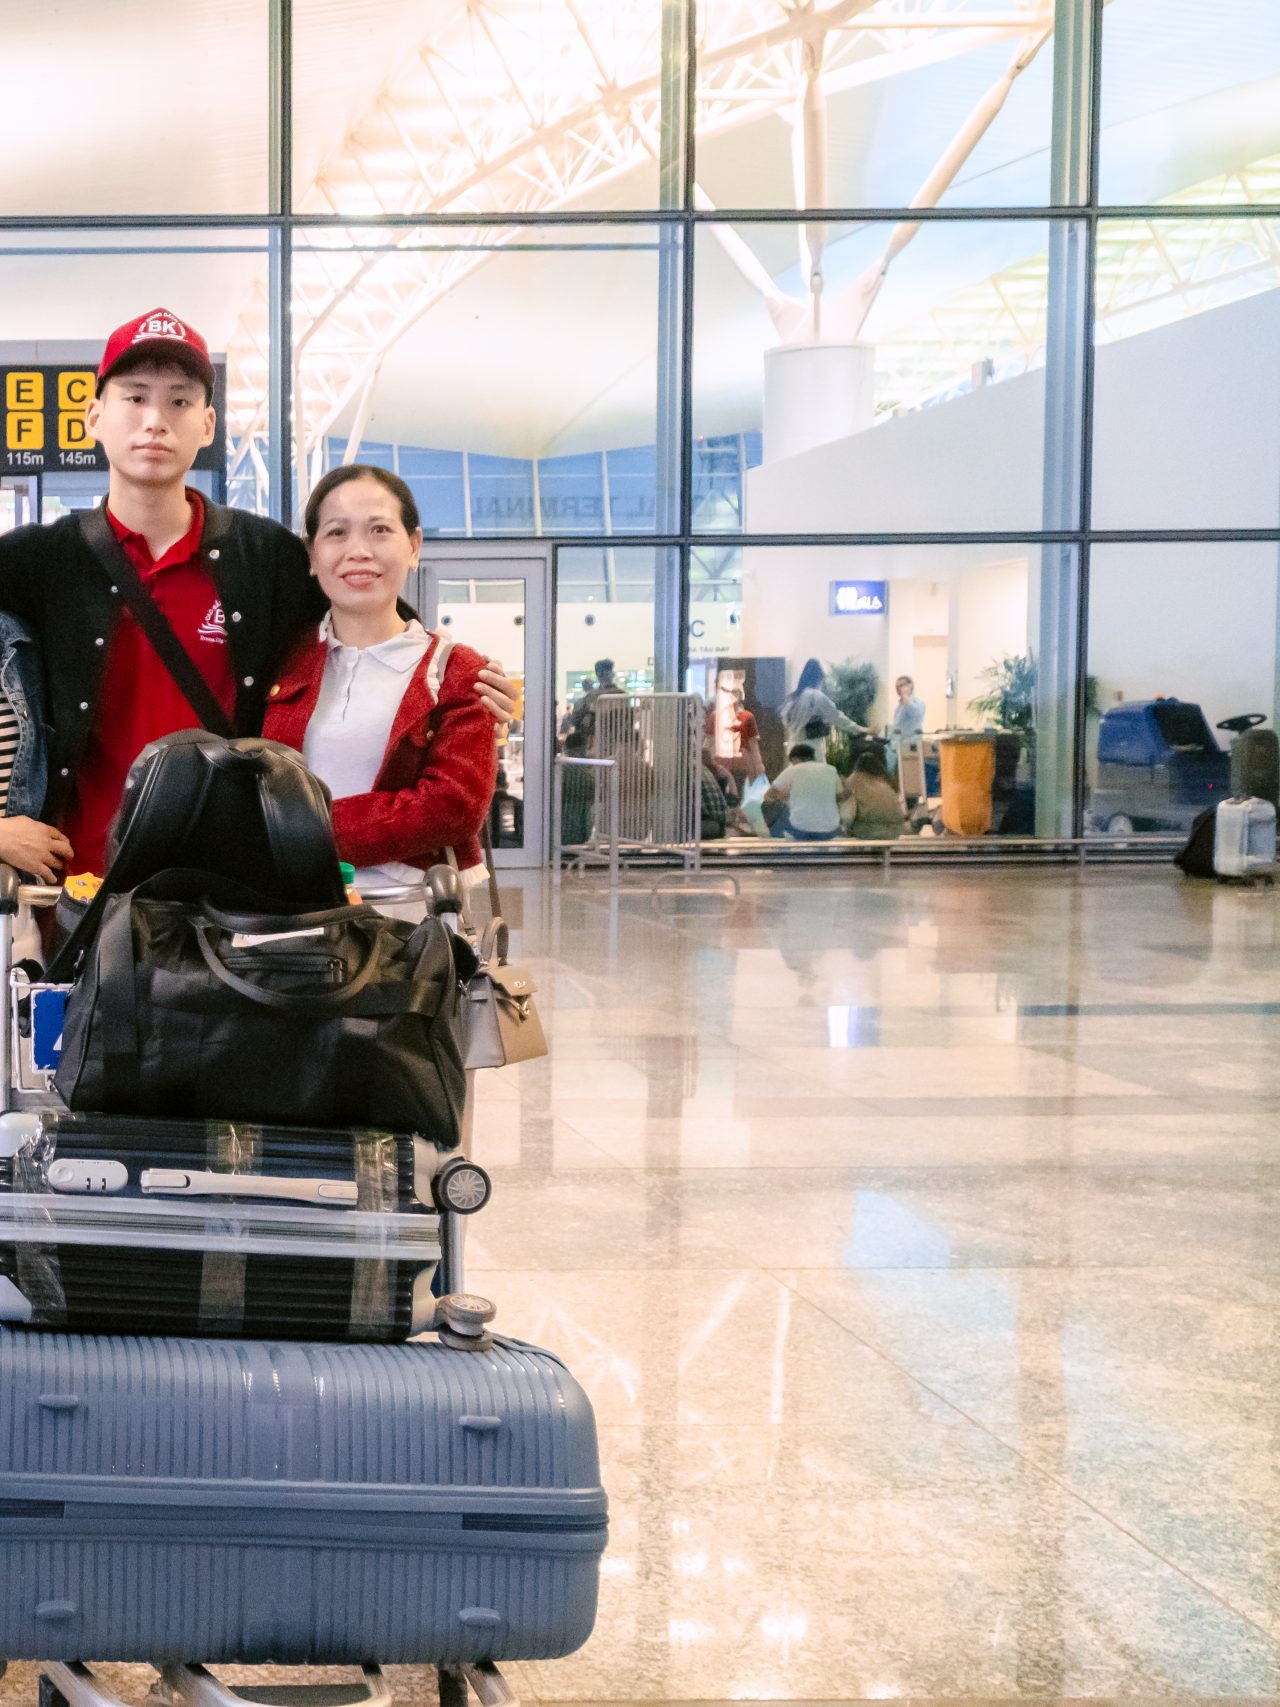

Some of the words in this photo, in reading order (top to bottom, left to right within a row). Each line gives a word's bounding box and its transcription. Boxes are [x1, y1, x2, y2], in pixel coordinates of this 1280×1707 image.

[148, 320, 177, 334] BK
[16, 379, 34, 403] E
[66, 379, 87, 404] C
[17, 418, 34, 442] F
[66, 418, 87, 443] D
[7, 453, 44, 465] 115m
[59, 453, 96, 465] 145m
